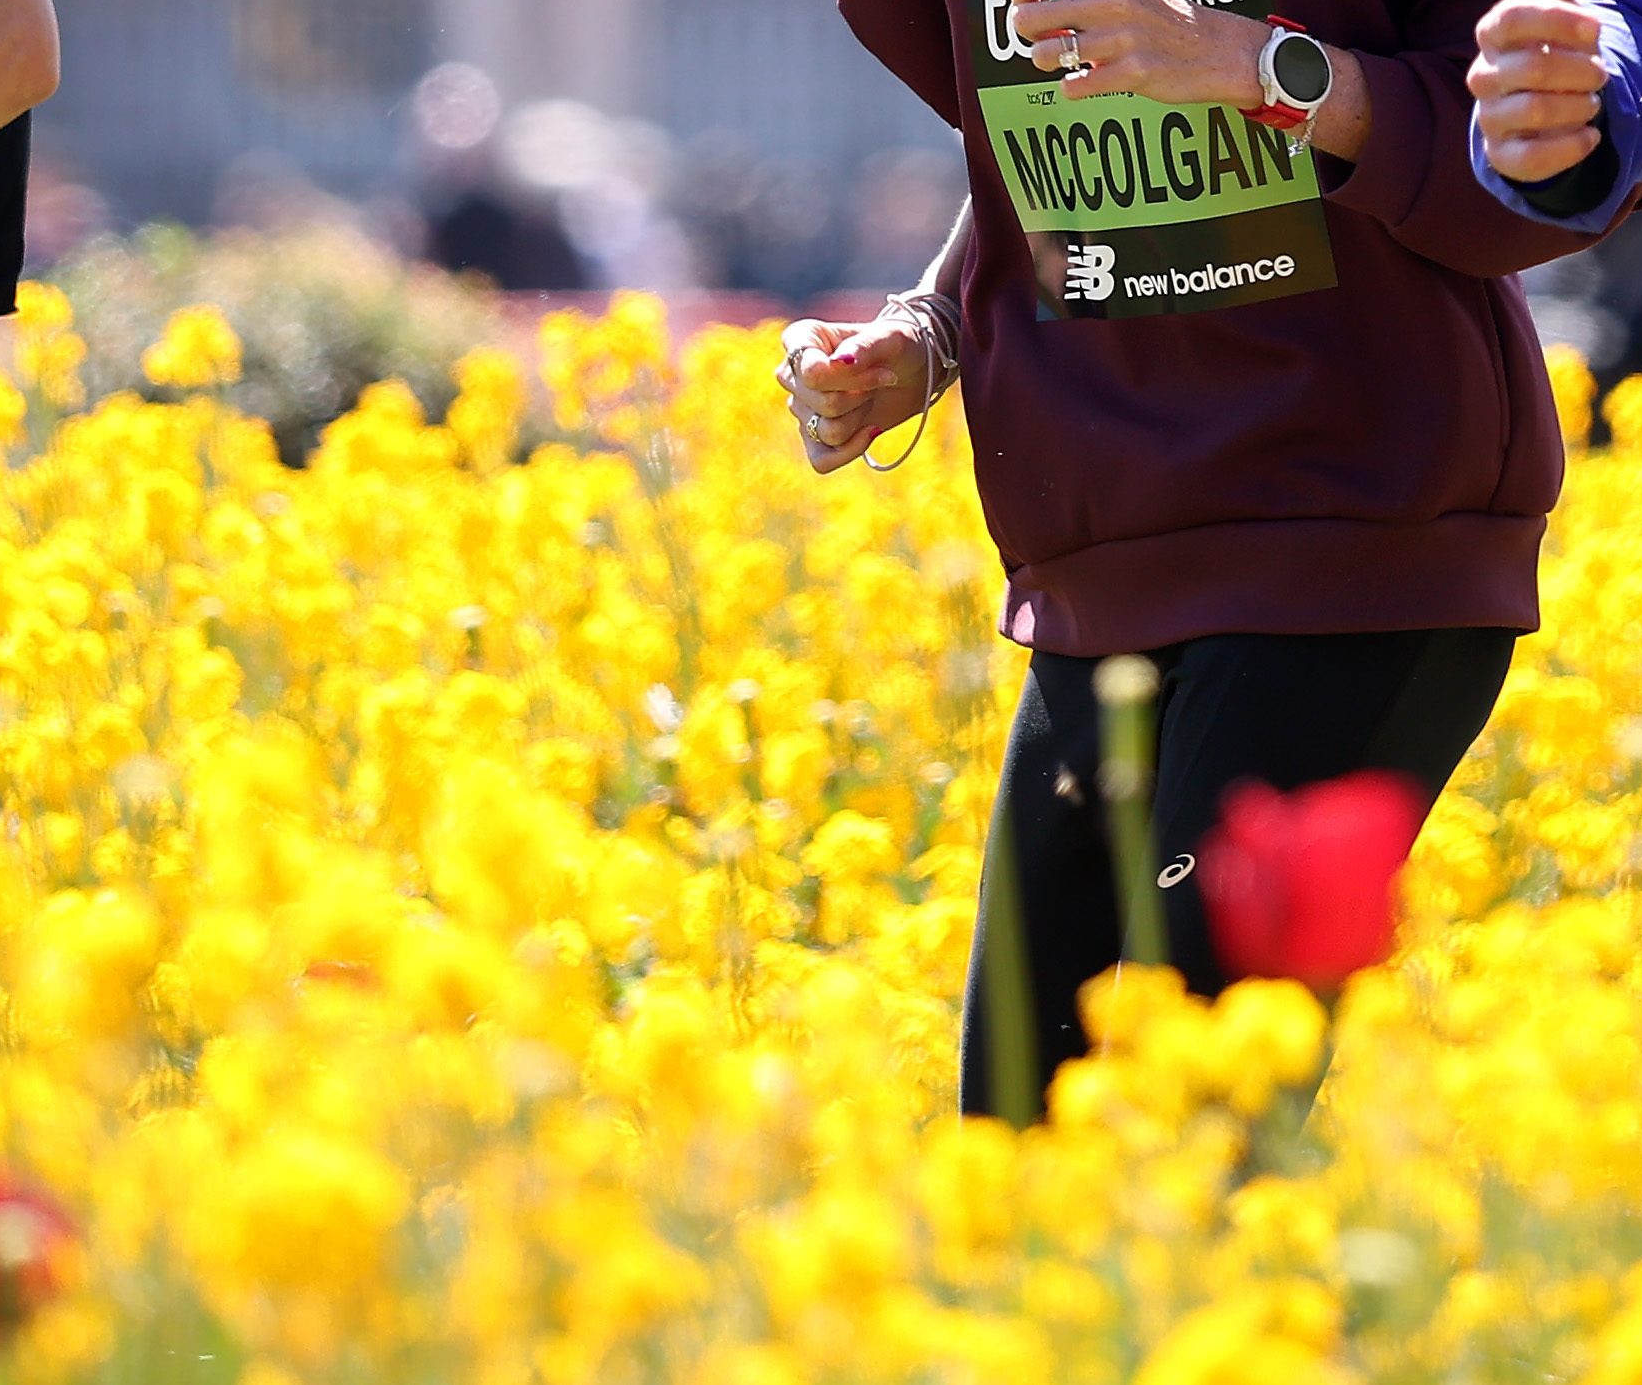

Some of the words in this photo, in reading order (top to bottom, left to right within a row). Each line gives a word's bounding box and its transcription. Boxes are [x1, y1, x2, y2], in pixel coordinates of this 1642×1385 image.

[1002, 105, 1295, 212] MCCOLGAN
[1123, 272, 1170, 299] new
[1172, 253, 1296, 296] balance
